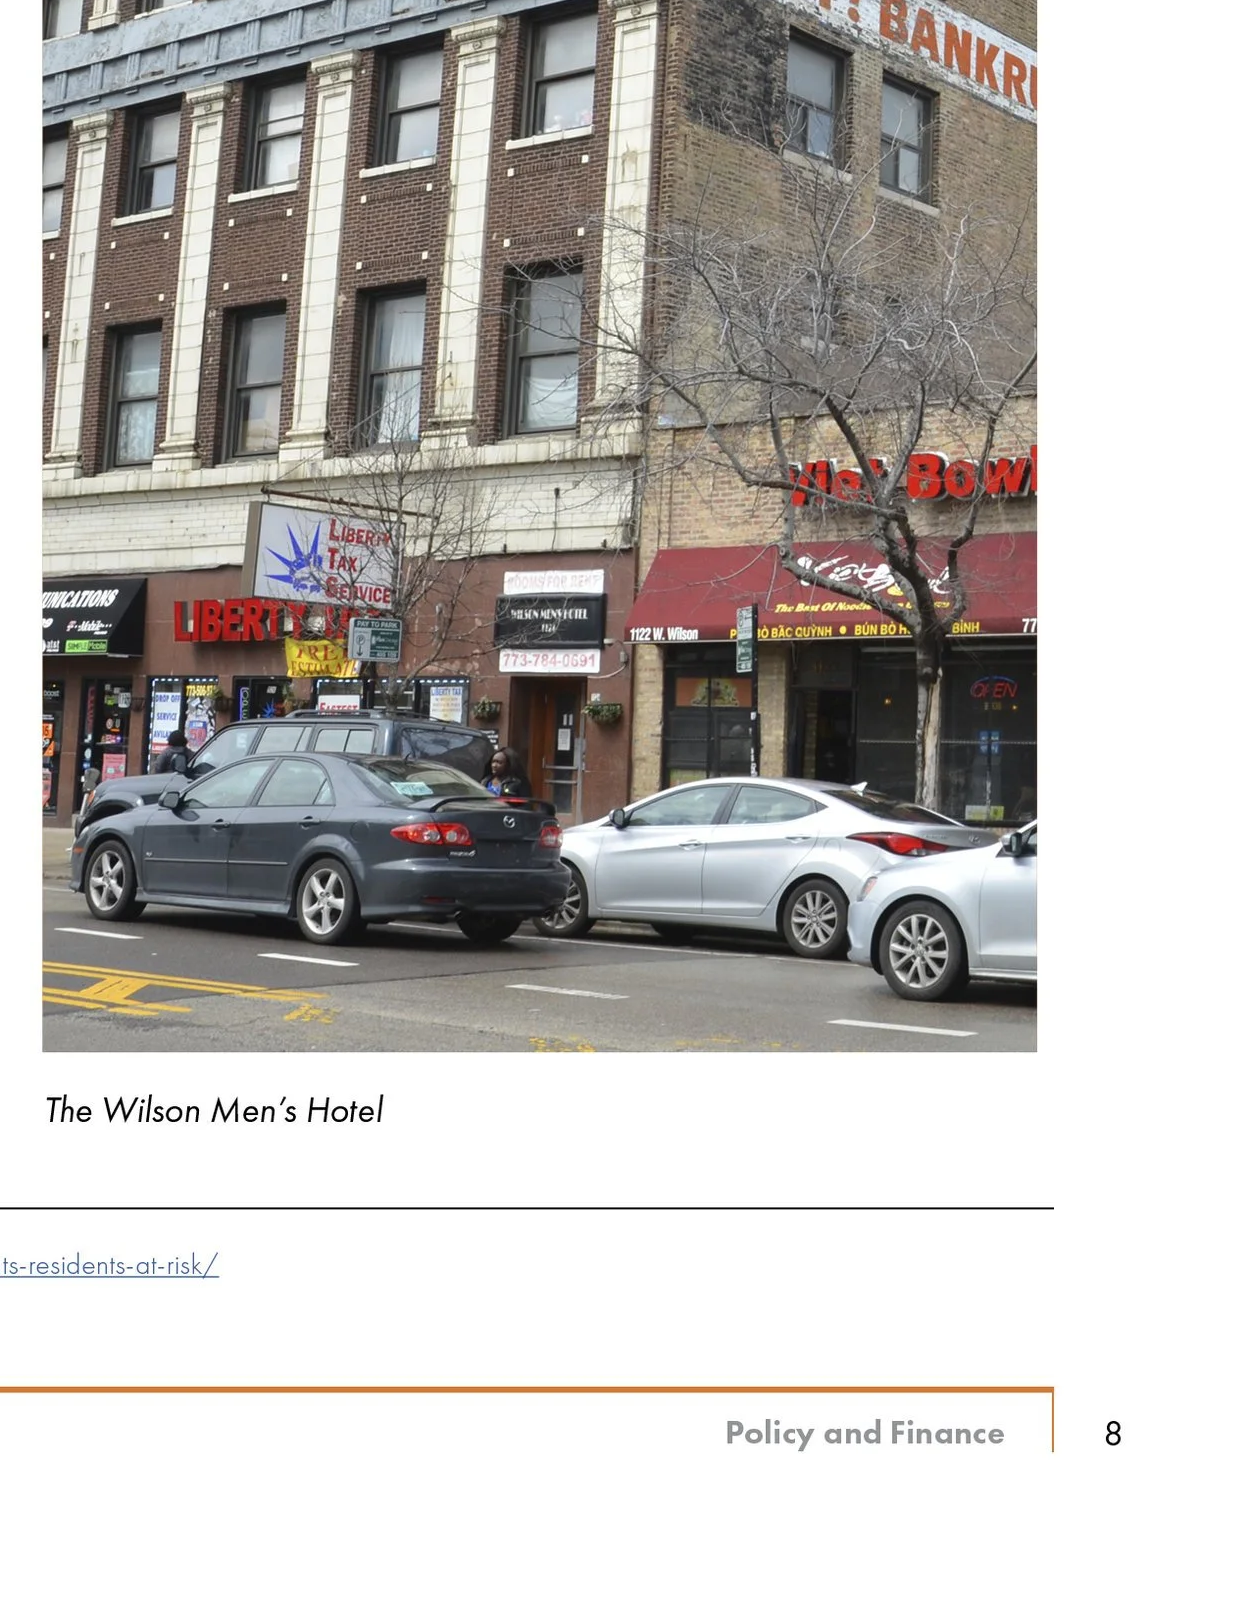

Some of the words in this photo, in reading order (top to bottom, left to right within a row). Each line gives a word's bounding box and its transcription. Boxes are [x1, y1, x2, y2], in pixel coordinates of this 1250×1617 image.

[327, 548, 358, 572] TAX
[324, 576, 391, 604] SERVICE
[821, 602, 838, 612] Of
[174, 598, 307, 642] LIBERTY
[381, 621, 398, 629] PARK
[630, 627, 652, 642] 1122
[652, 627, 665, 641] W.
[667, 626, 699, 641] Wilson
[503, 653, 596, 668] 773-784-0691
[47, 1094, 92, 1122] The
[104, 1094, 199, 1123] Wilson
[211, 1096, 296, 1122] Men’s
[308, 1094, 384, 1122] Hotel
[728, 1419, 814, 1451] Policy
[825, 1419, 880, 1443] and
[892, 1420, 1004, 1443] Finance
[1106, 1421, 1121, 1446] 8
